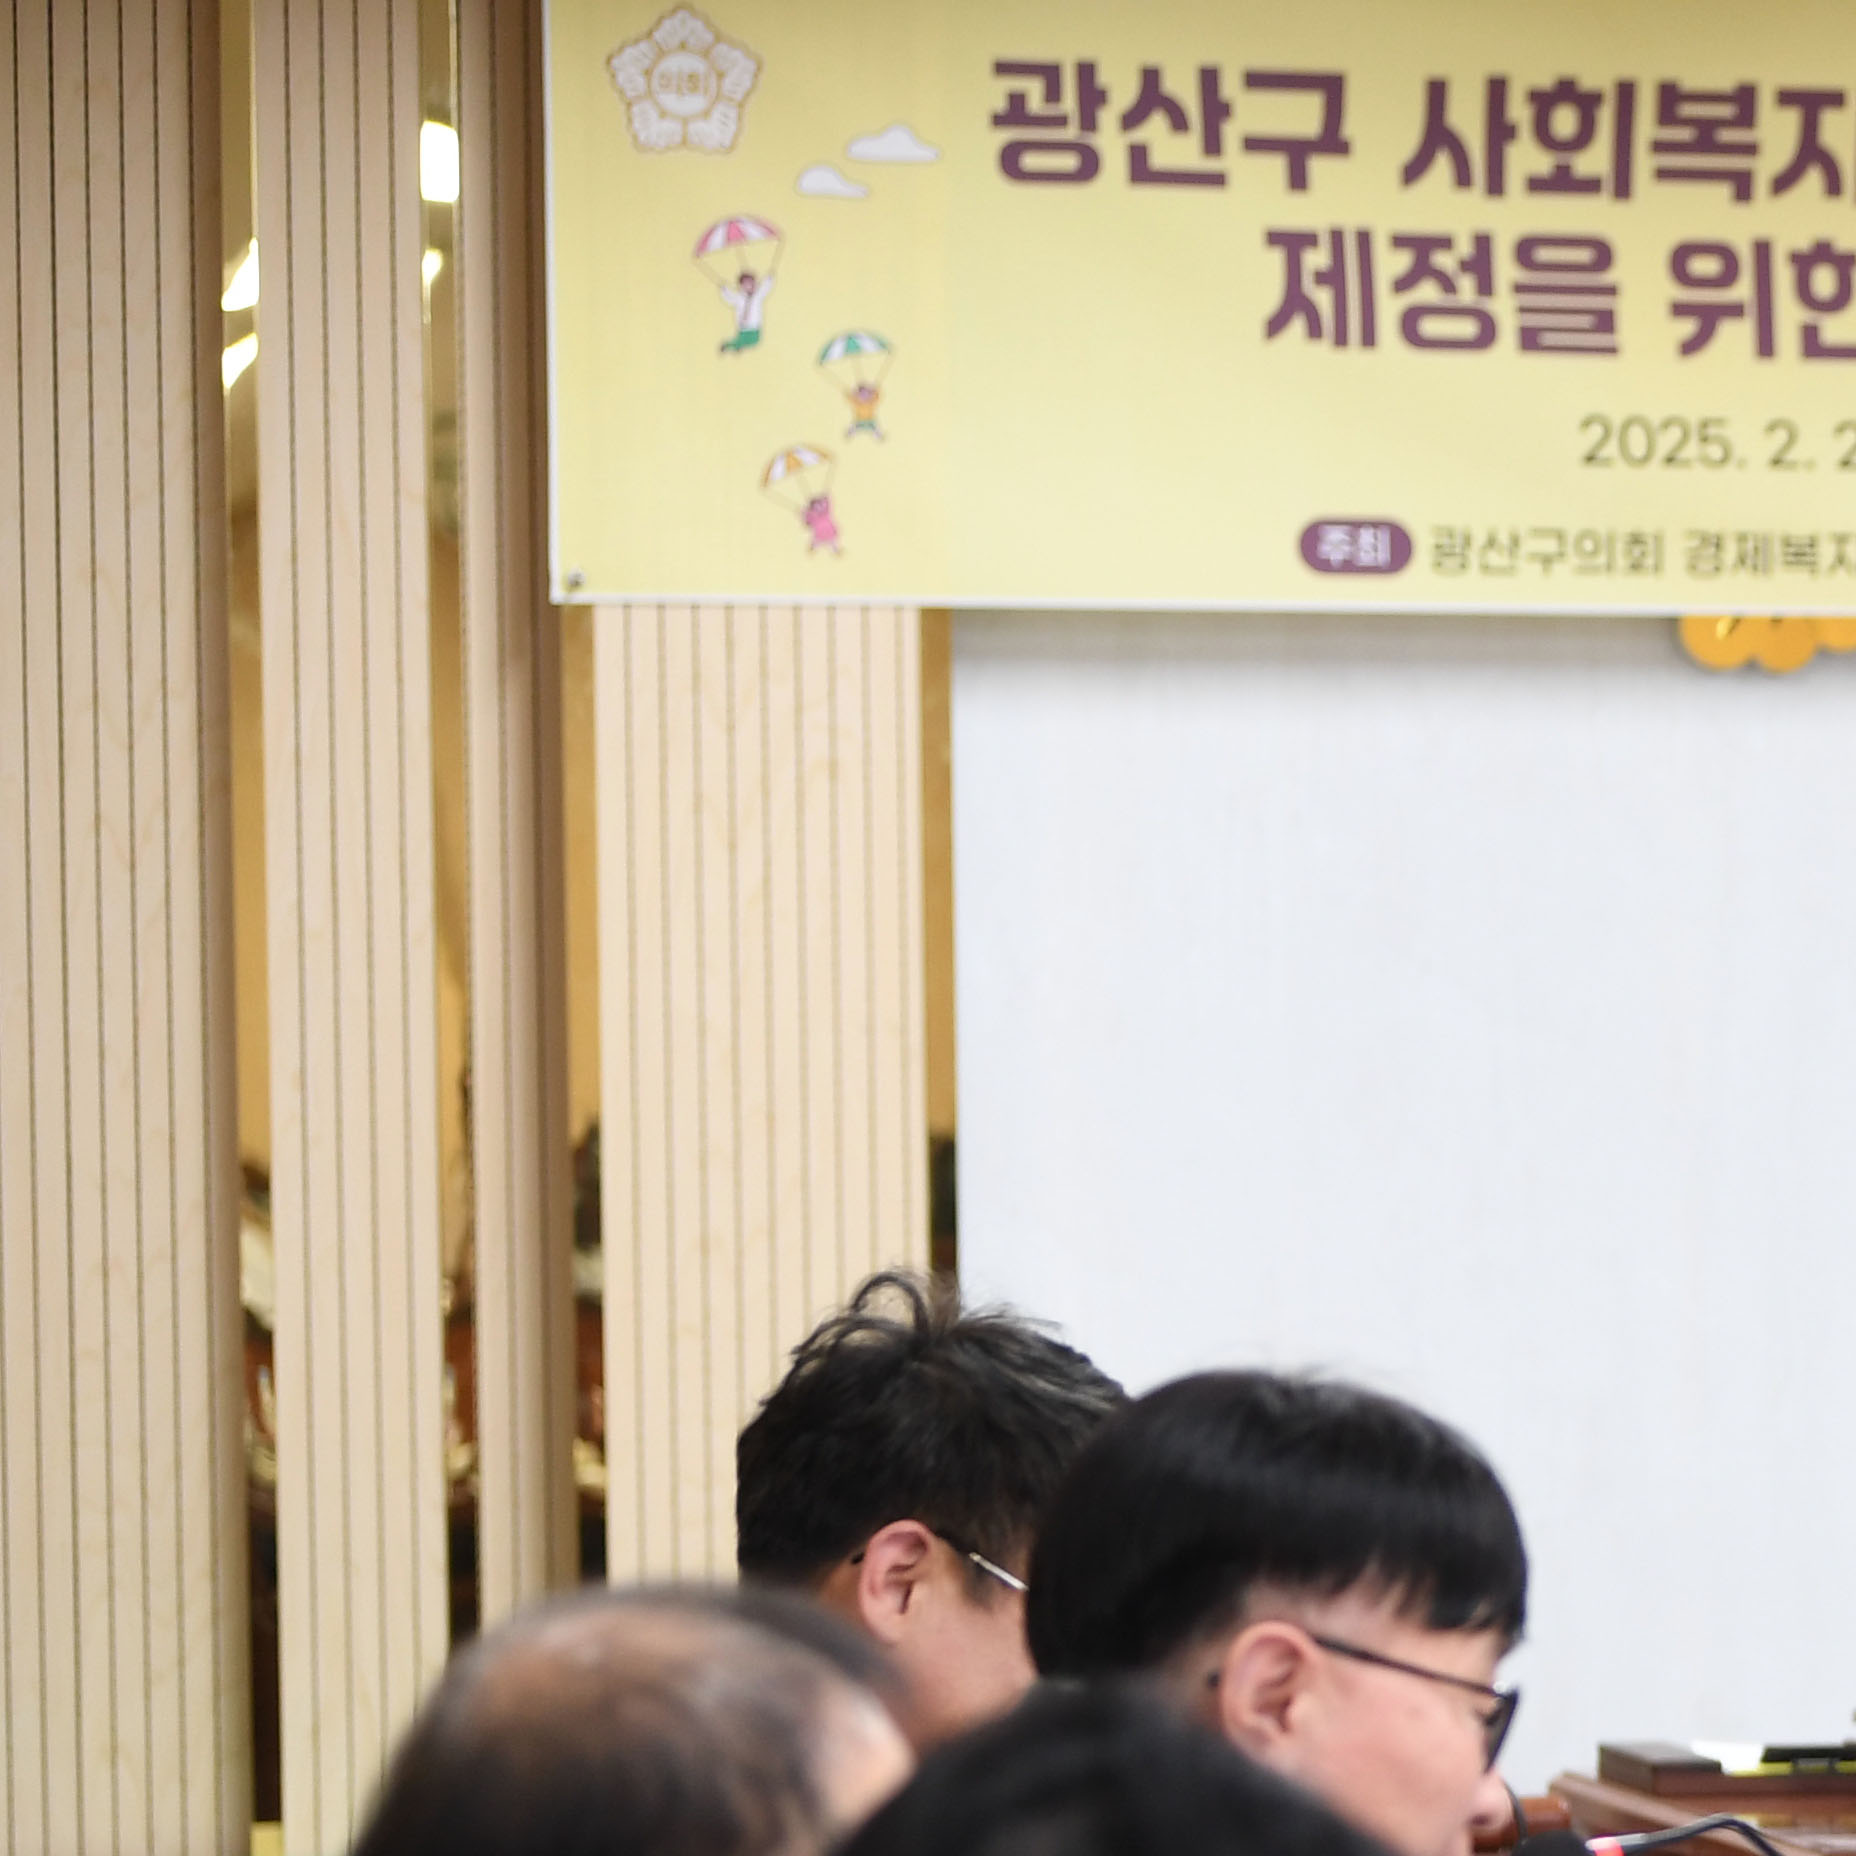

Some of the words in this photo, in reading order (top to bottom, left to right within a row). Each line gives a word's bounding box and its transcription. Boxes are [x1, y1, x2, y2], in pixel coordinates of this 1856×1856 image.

[990, 59, 1353, 194] 광산구
[1264, 227, 1622, 358] 제정을
[1578, 413, 1748, 471] 2025.
[1763, 418, 1816, 473] 2.
[1429, 524, 1667, 579] 광산구의회
